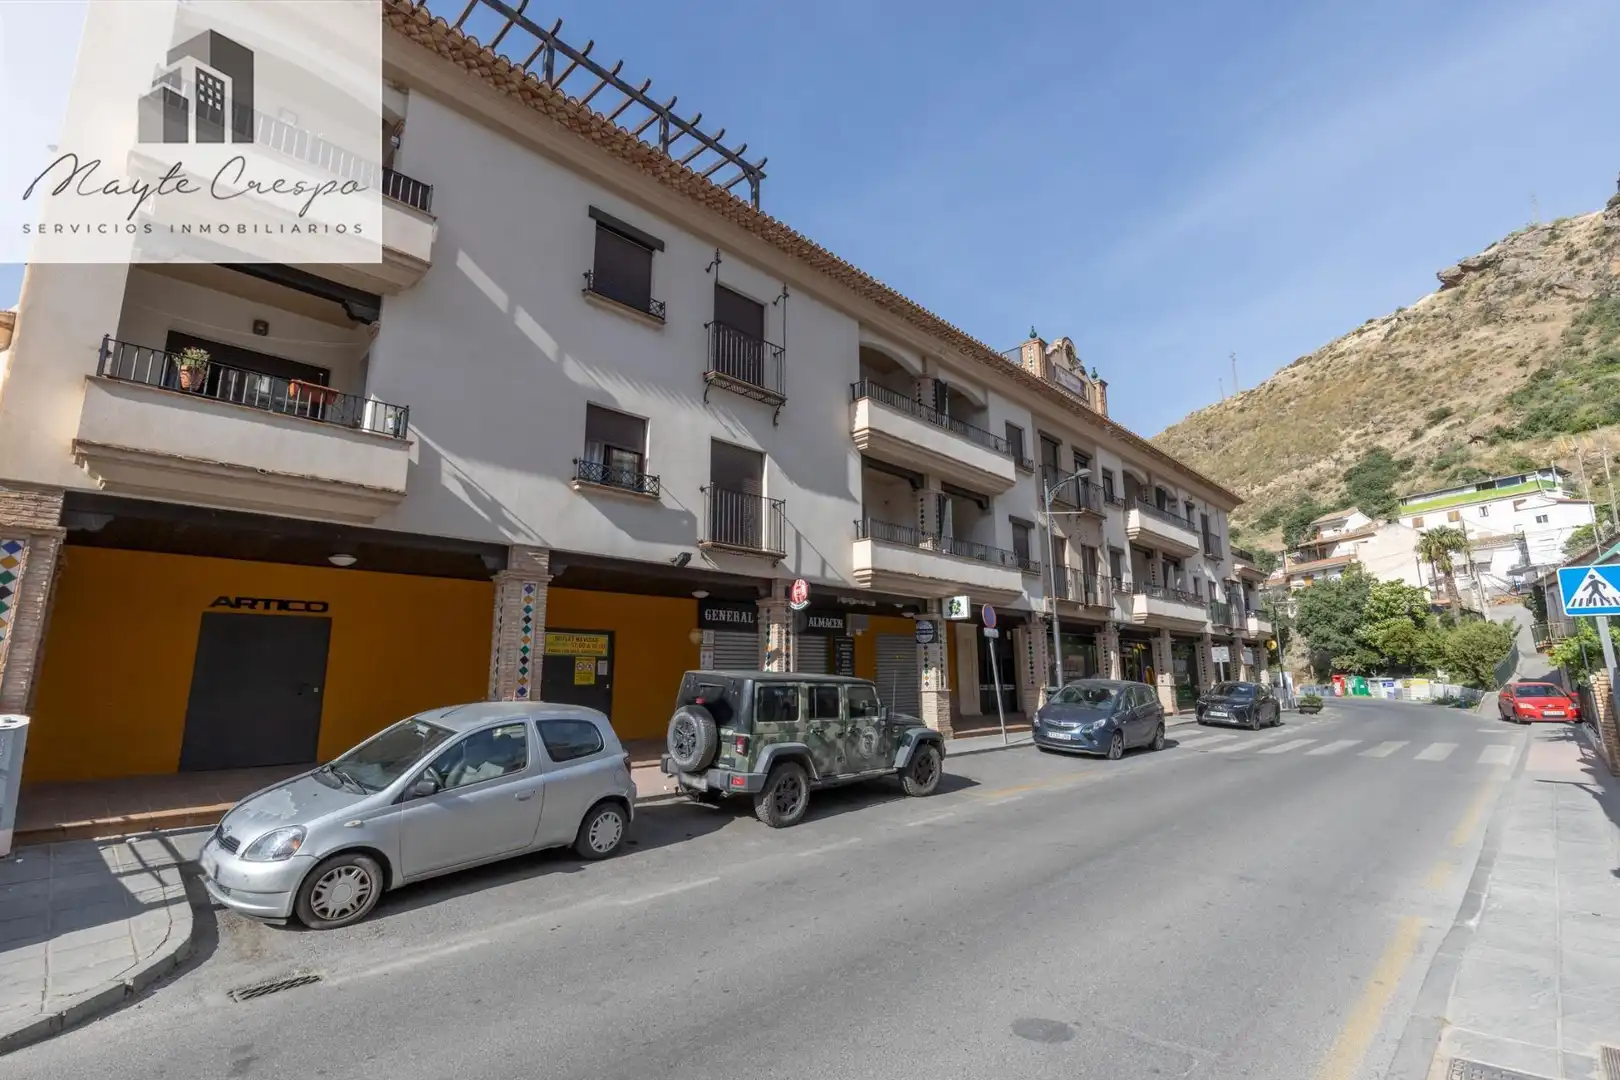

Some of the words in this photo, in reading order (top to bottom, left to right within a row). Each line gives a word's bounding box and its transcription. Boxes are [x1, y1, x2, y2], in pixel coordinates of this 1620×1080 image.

[208, 596, 329, 613] ARTICO
[704, 608, 754, 624] GENERAL
[808, 616, 843, 629] ALMACEN
